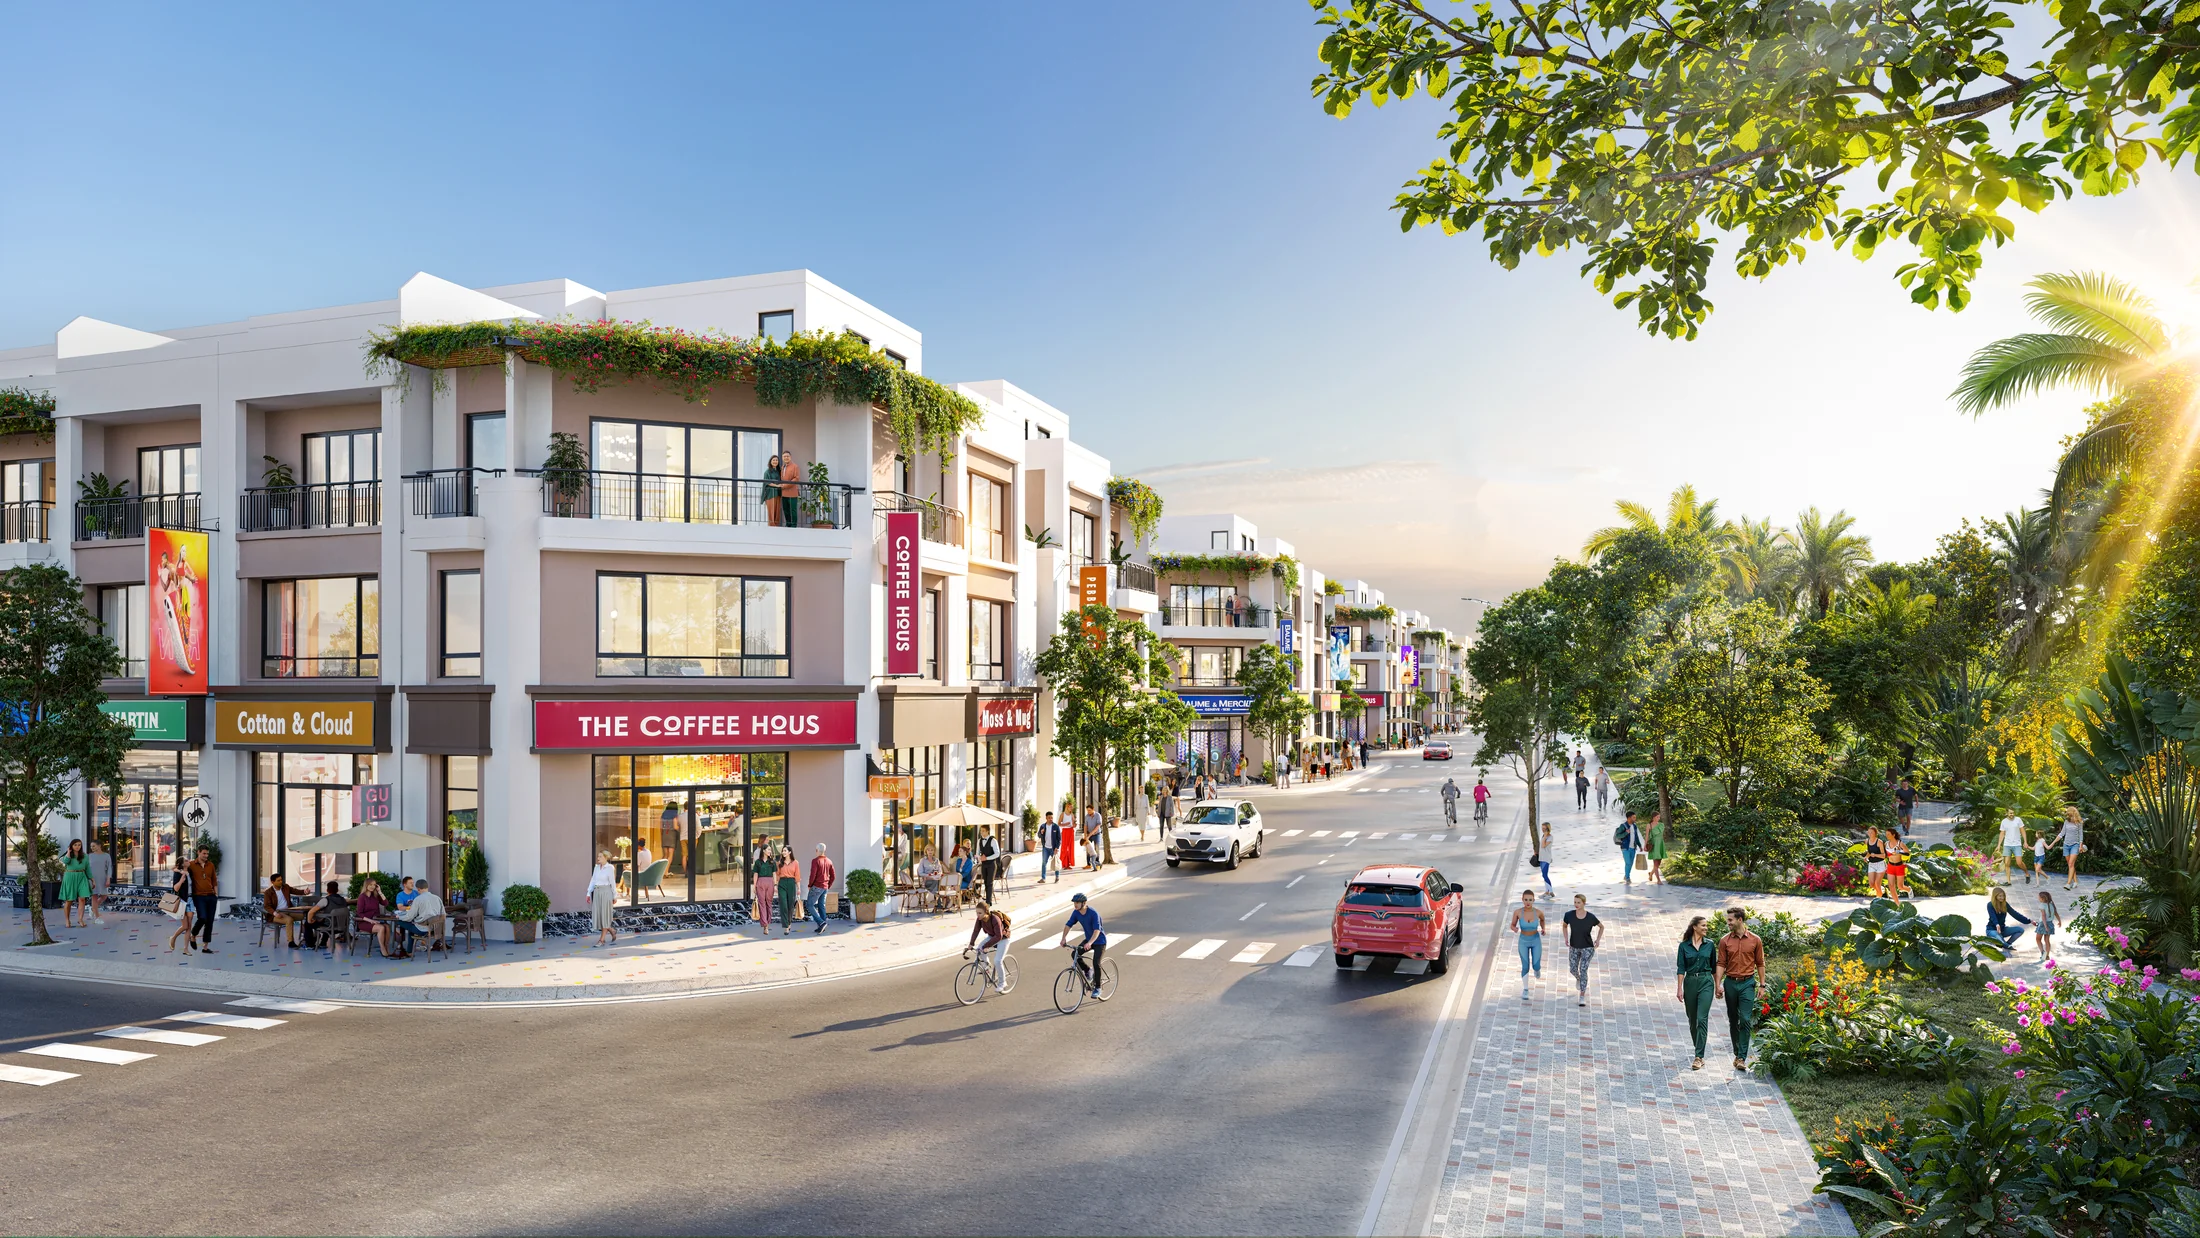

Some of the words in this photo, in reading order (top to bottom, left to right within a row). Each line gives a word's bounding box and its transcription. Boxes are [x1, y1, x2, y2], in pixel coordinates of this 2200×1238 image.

[895, 535, 910, 599] COFFEE
[895, 606, 910, 652] HOUS
[1284, 624, 1292, 652] BAUME
[1363, 696, 1377, 705] OUS
[291, 711, 306, 735] &
[310, 710, 353, 736] Cloud
[578, 716, 629, 737] THE
[640, 715, 740, 737] COFFEE
[752, 714, 820, 735] HOUS
[982, 709, 1004, 729] Moss
[1006, 710, 1014, 727] &
[1015, 708, 1031, 729] Mug
[365, 787, 389, 803] GU
[877, 782, 902, 793] LEAF
[366, 804, 389, 820] ILD
